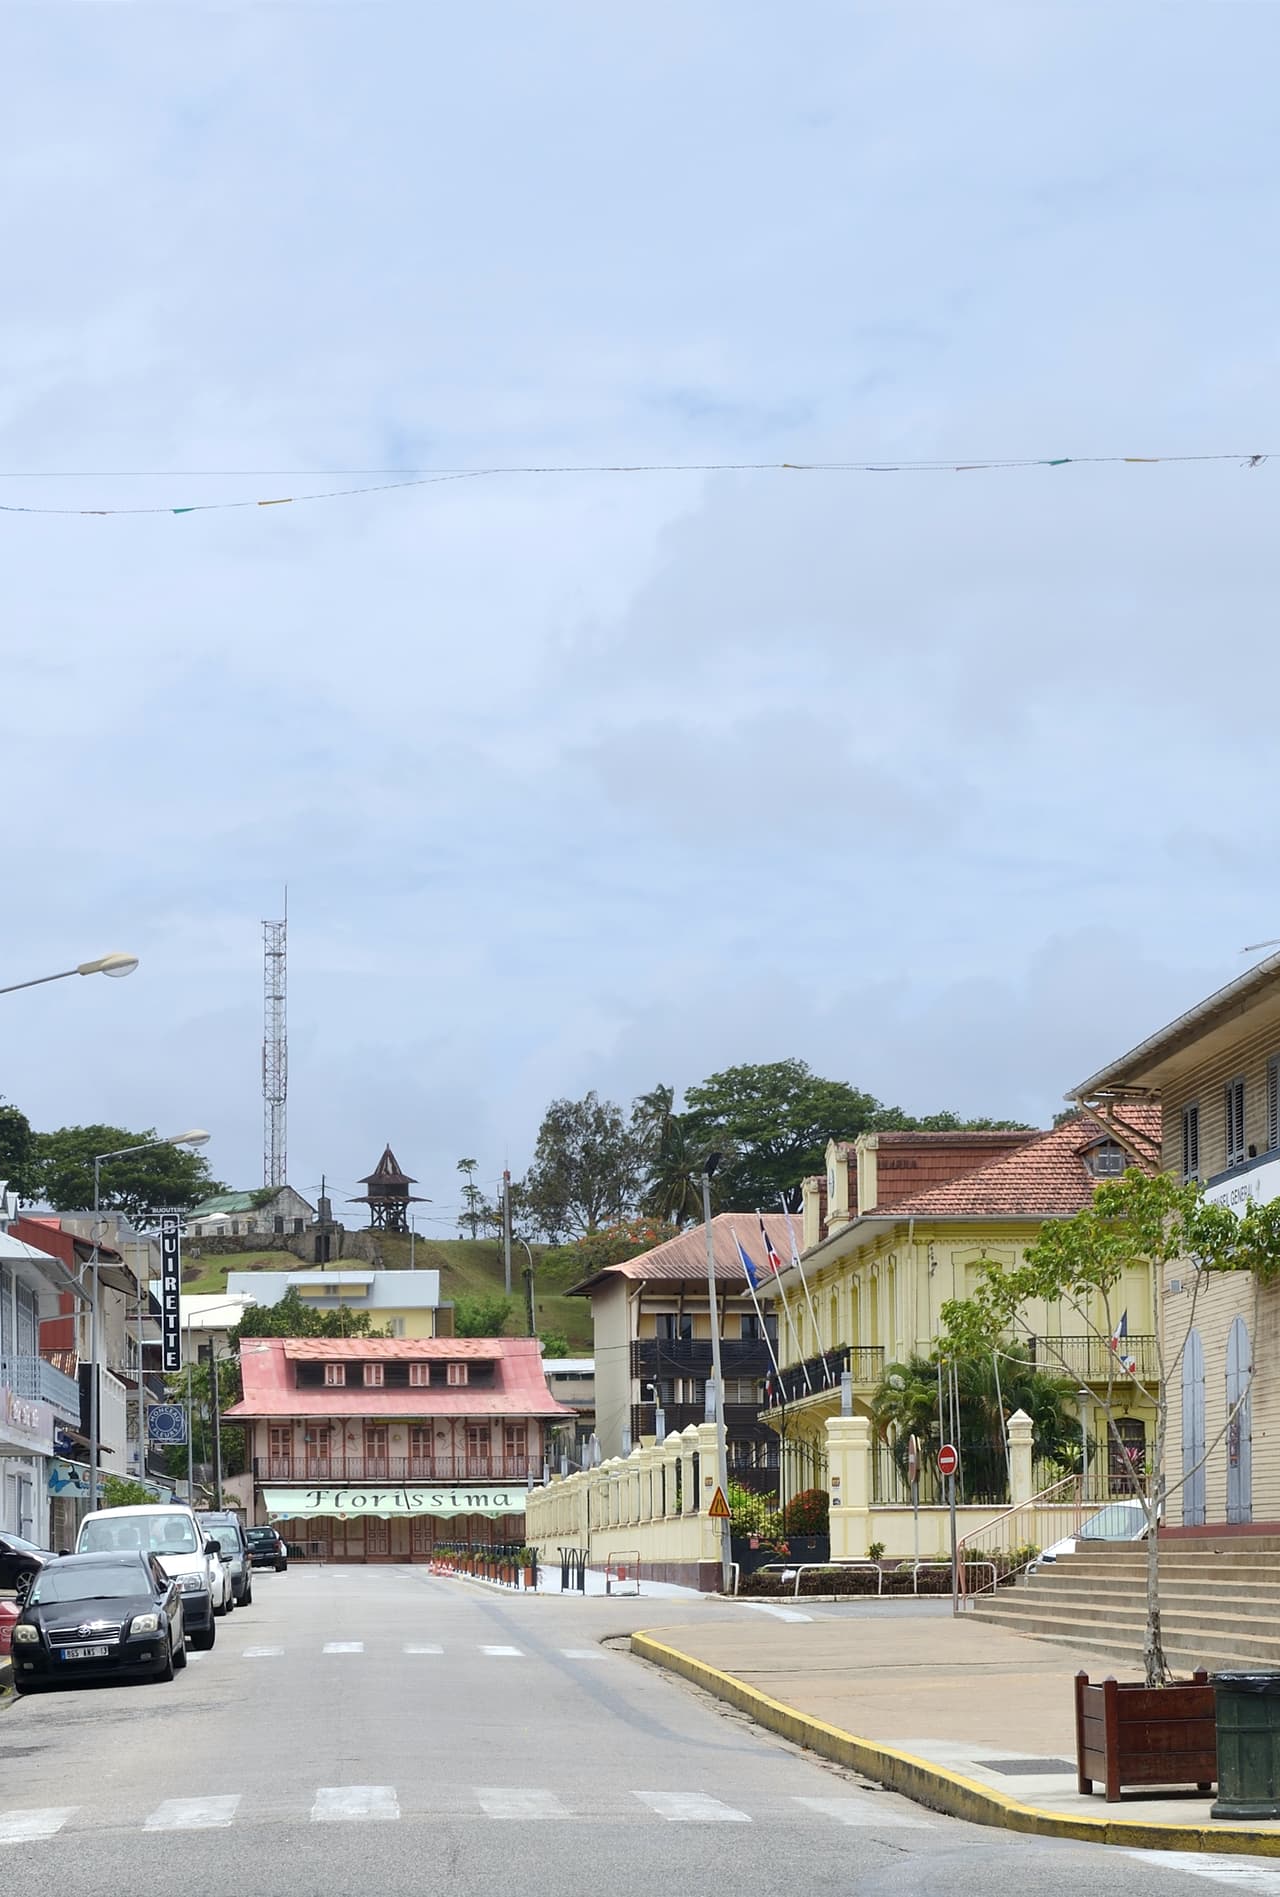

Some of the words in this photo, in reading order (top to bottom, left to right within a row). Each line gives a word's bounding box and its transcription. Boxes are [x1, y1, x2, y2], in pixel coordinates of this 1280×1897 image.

[163, 1220, 178, 1367] BUIRETTE
[150, 1407, 181, 1422] MONCEAU
[152, 1427, 179, 1438] FLEURS
[305, 1490, 513, 1509] Florissima
